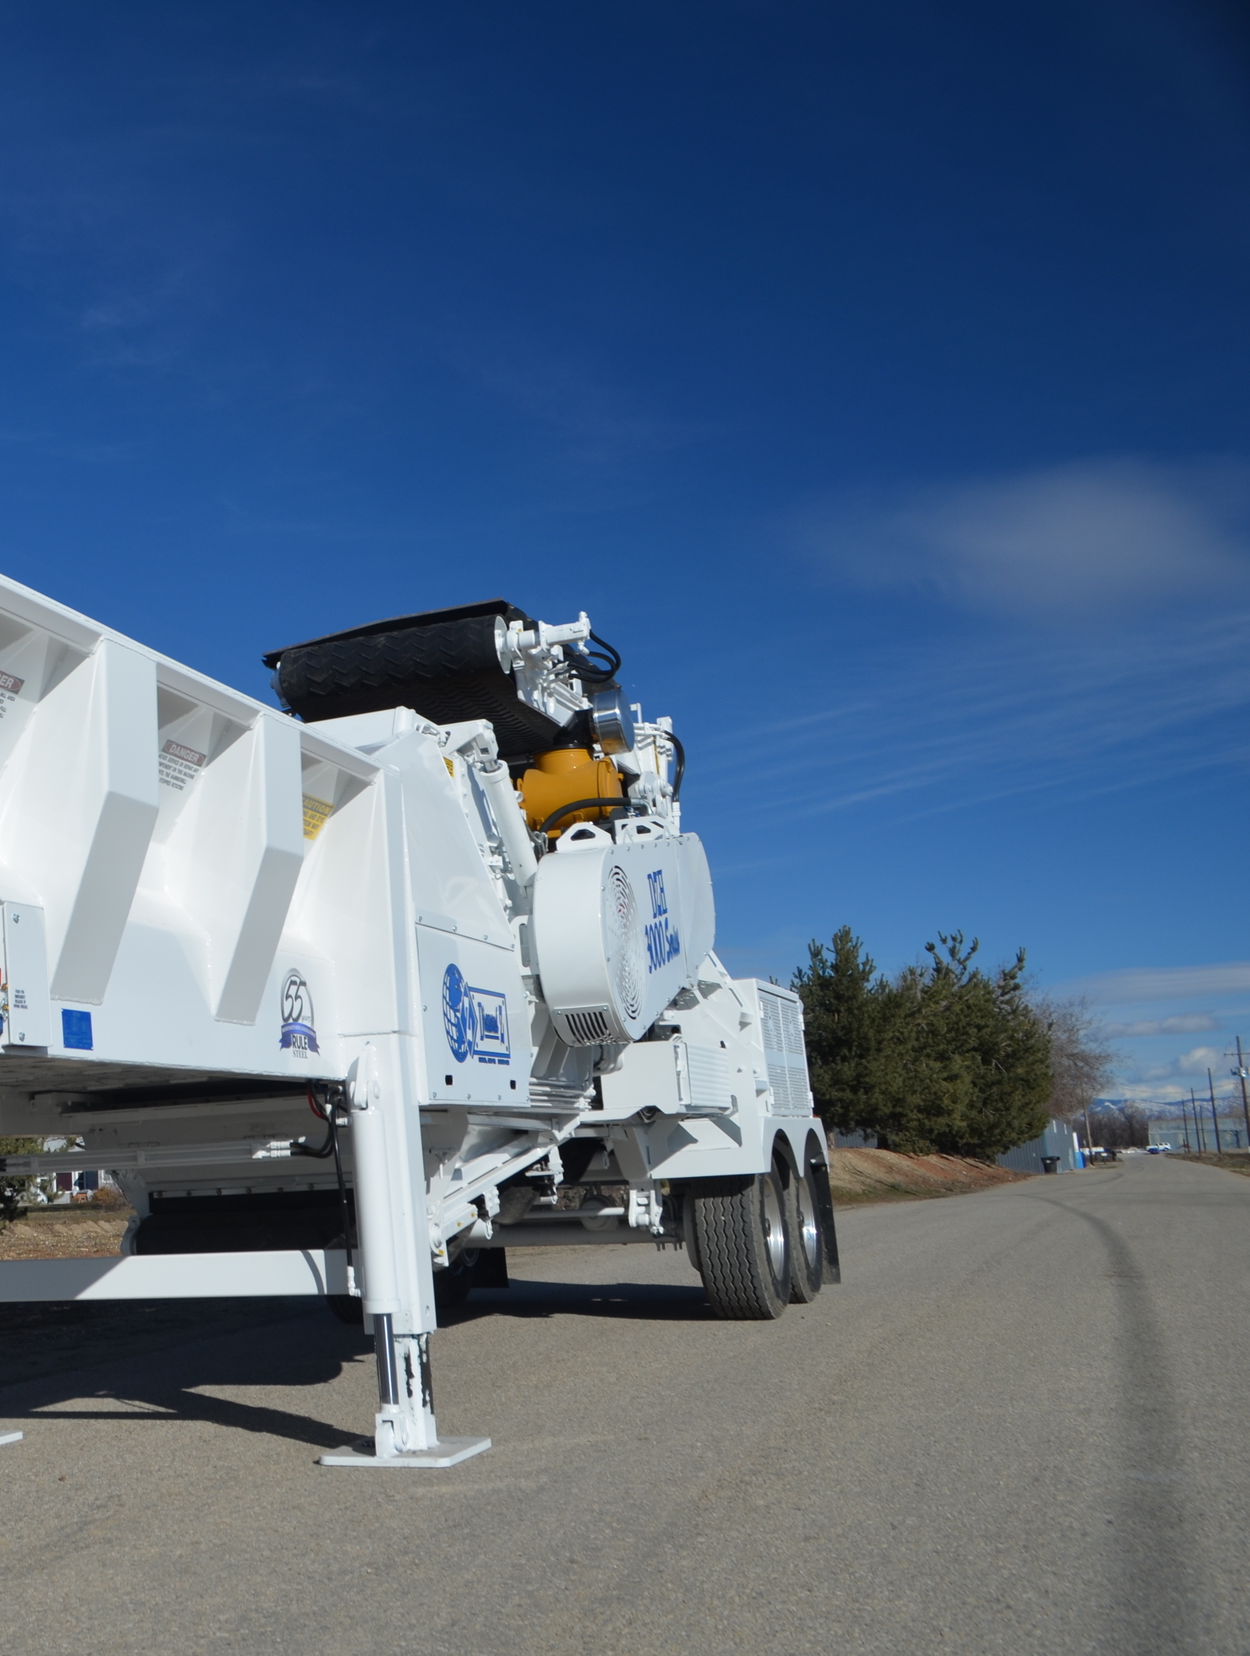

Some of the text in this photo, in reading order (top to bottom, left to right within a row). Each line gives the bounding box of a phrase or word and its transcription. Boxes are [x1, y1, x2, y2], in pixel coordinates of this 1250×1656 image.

[169, 744, 200, 763] DANGER
[303, 797, 331, 816] AUTION
[647, 869, 668, 919] DZH
[282, 979, 307, 1023] 55
[292, 1033, 308, 1050] RULE
[292, 1050, 309, 1059] STEEL
